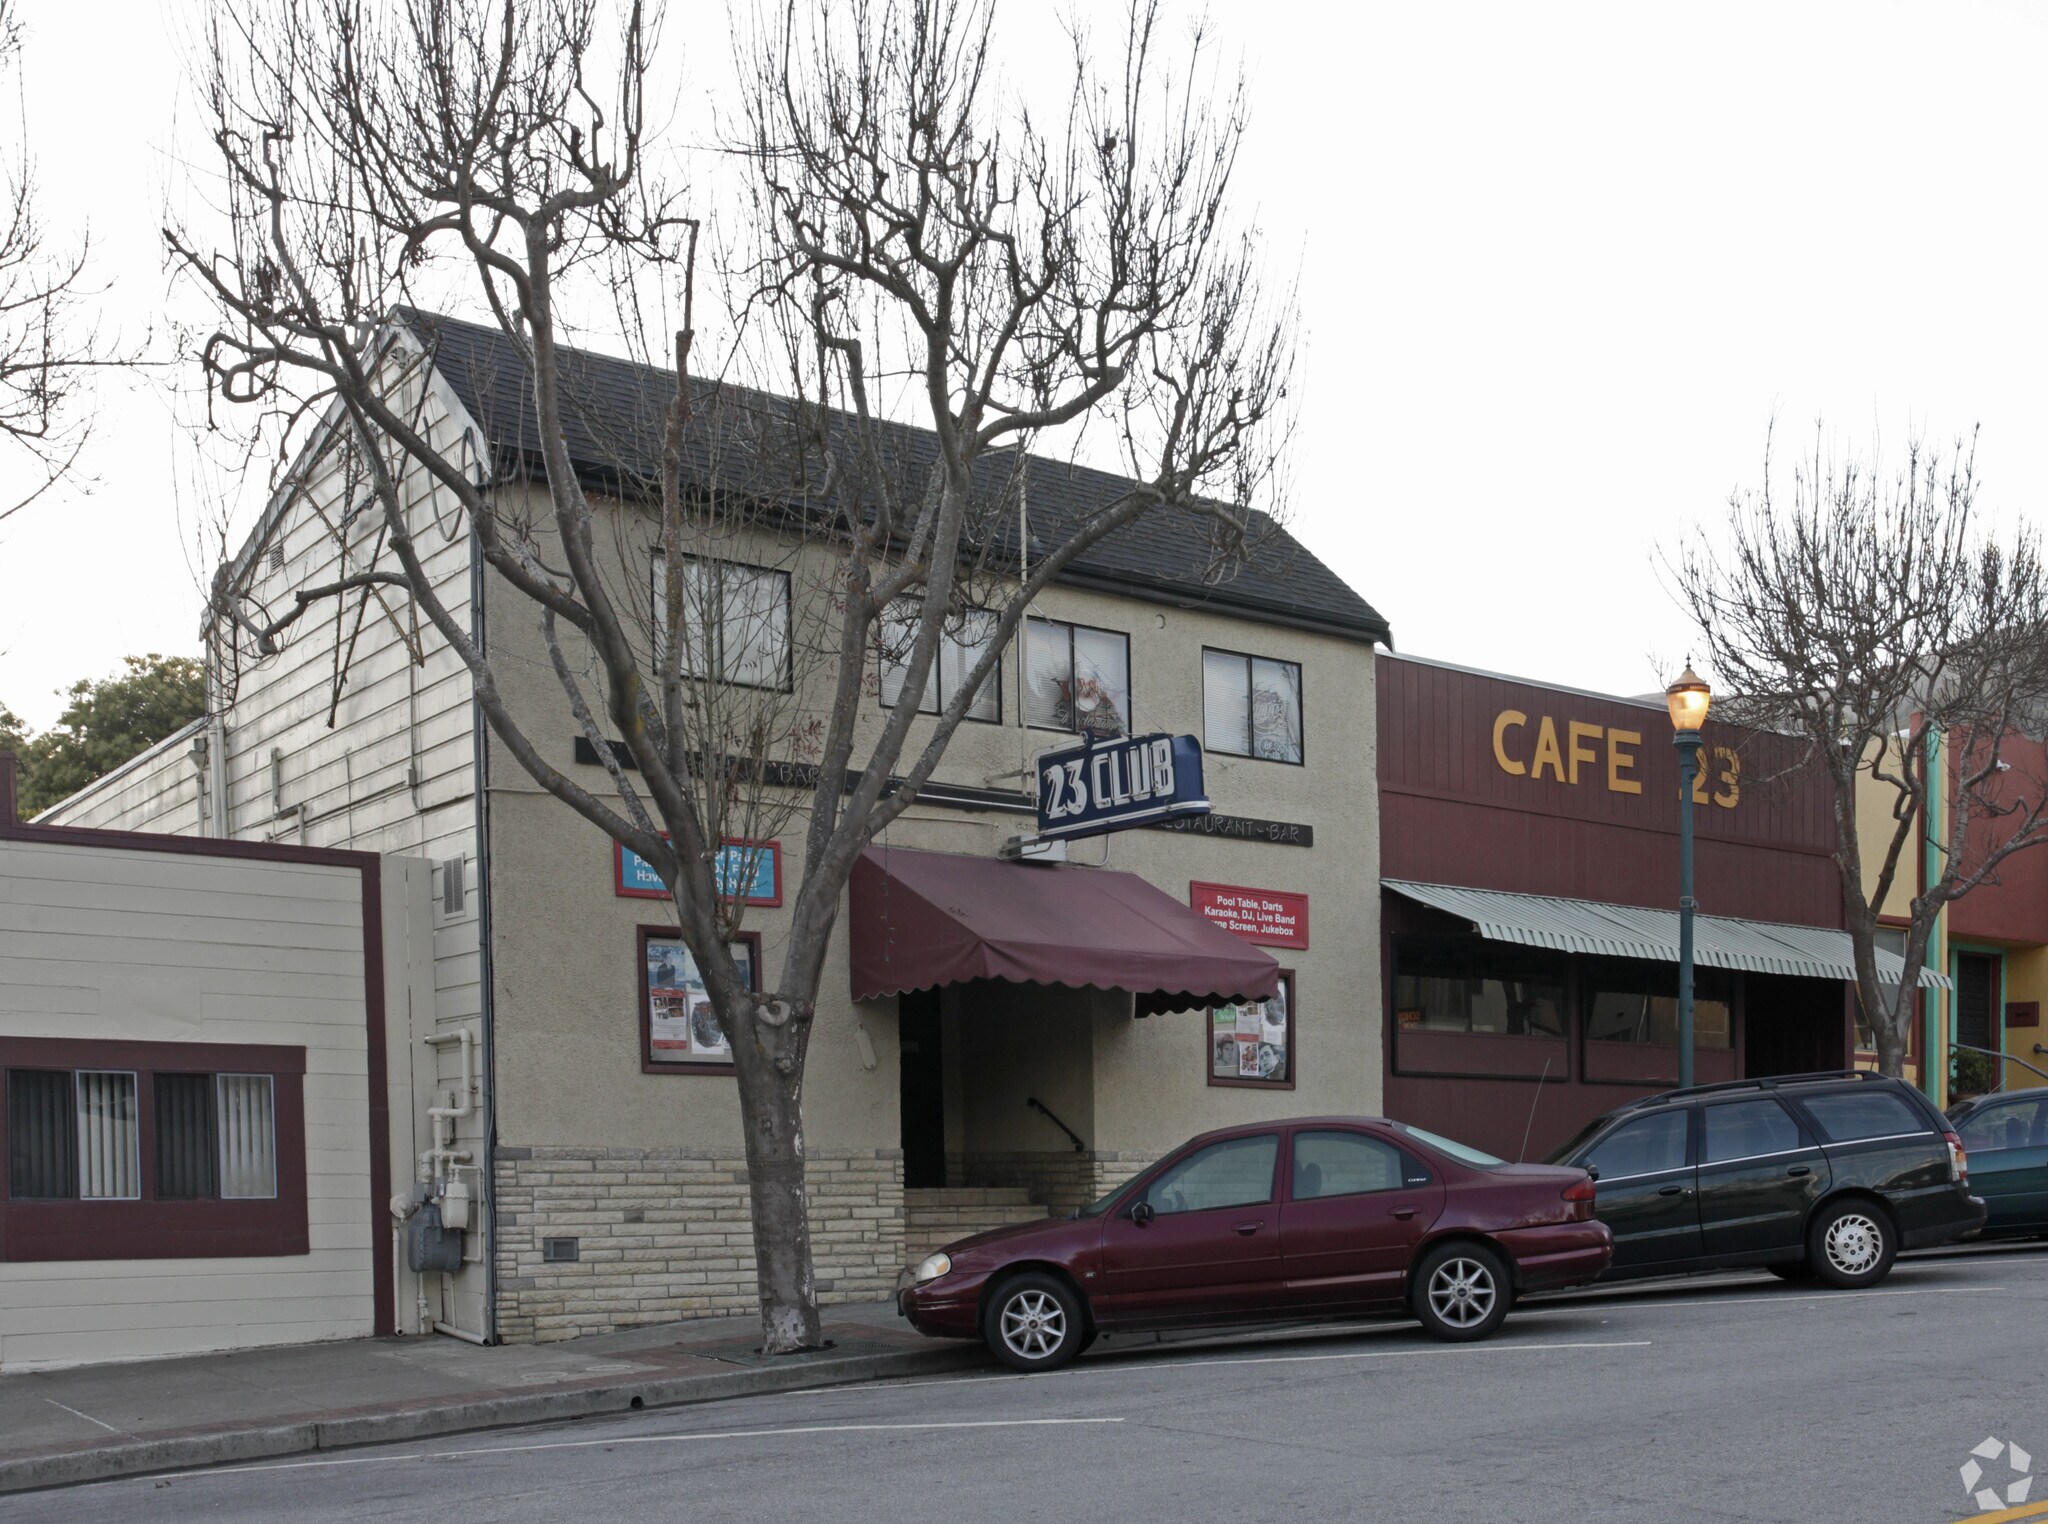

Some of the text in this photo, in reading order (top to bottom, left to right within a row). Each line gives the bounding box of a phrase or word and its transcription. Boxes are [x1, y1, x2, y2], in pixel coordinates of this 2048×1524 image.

[1493, 709, 1741, 809] CAFE 23
[1043, 737, 1176, 819] 23 CLUB
[1161, 814, 1254, 836] STAURANT
[1269, 823, 1299, 843] BAR
[732, 864, 760, 877] Fd
[1217, 895, 1283, 911] Pool Table, Darts
[1204, 906, 1295, 925] Karaoke, DJ, Live Band
[1229, 920, 1259, 933] Screen,
[1261, 924, 1294, 936] Jukebox
